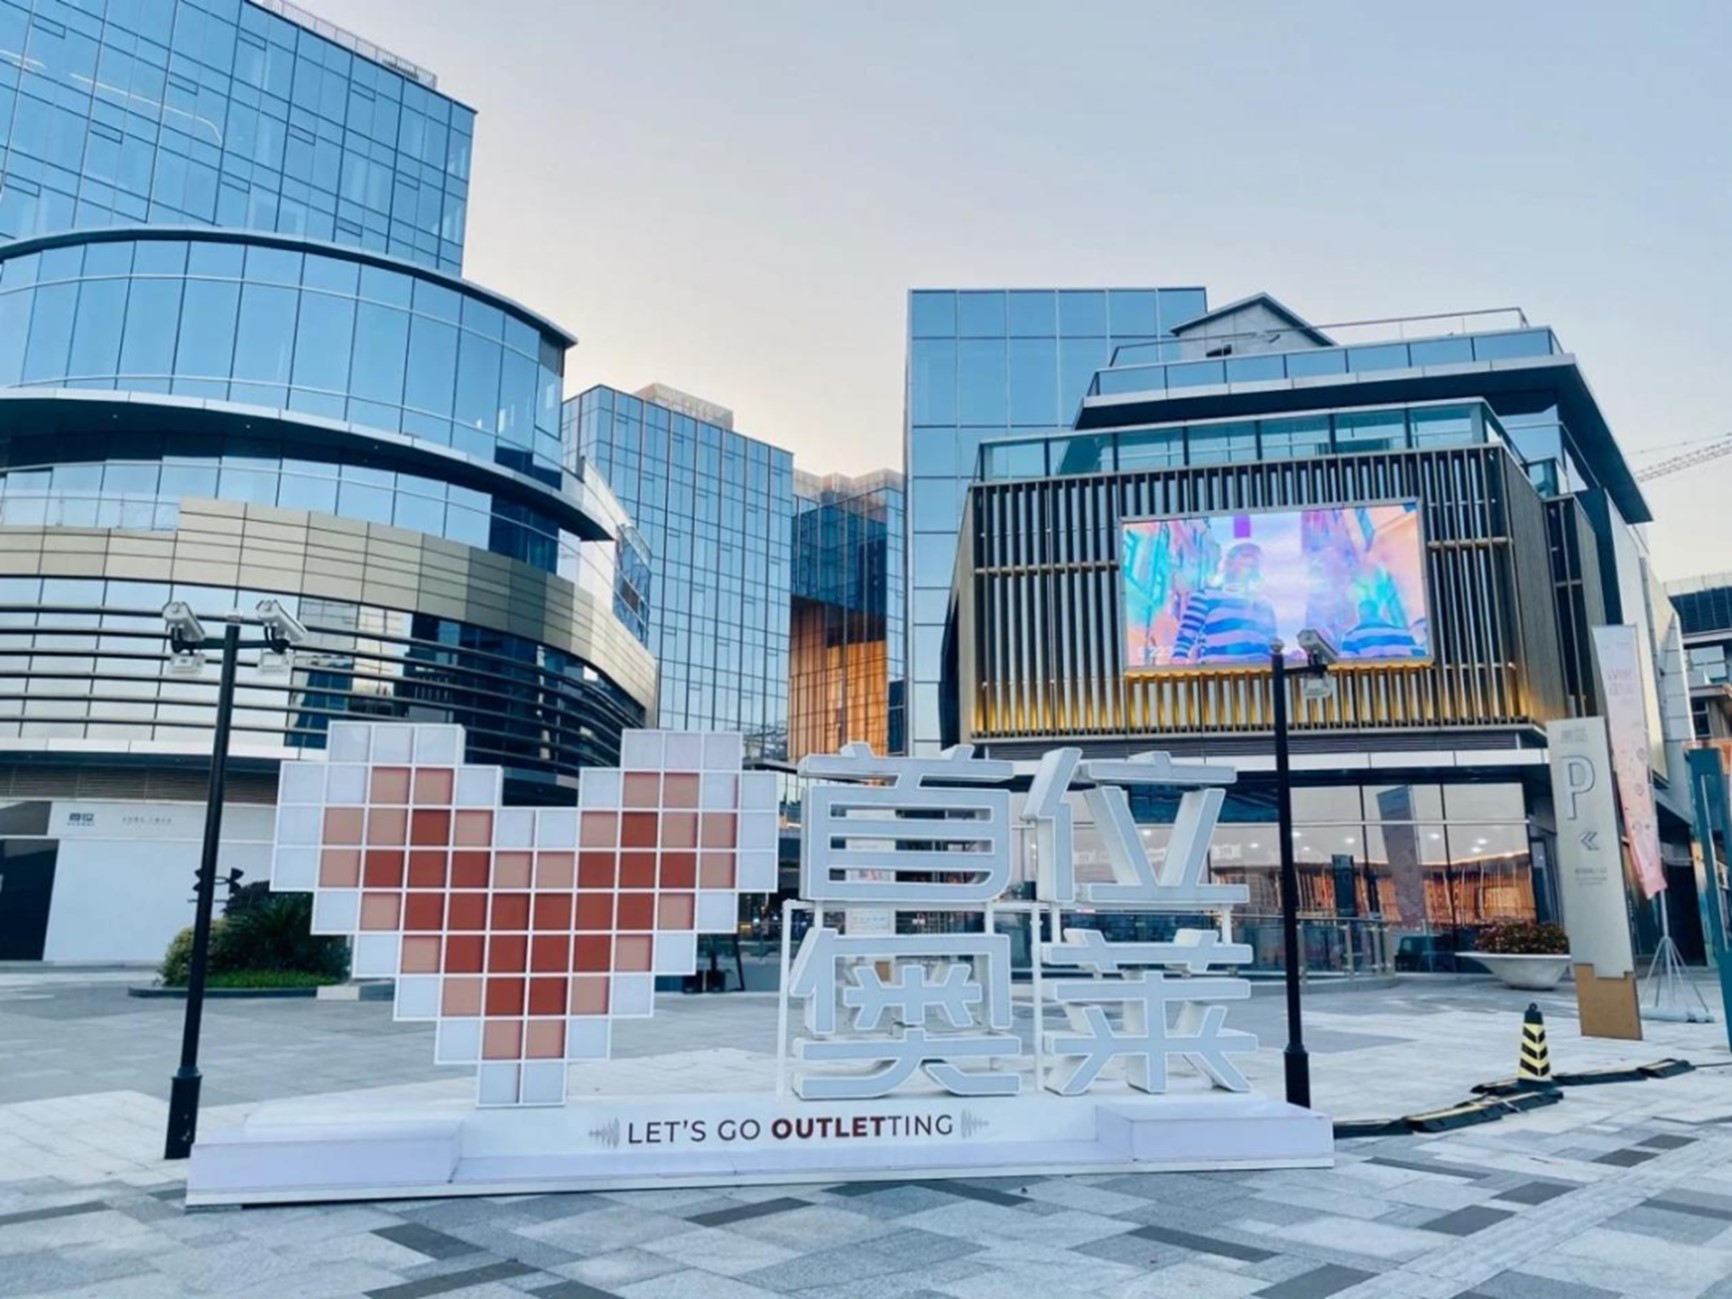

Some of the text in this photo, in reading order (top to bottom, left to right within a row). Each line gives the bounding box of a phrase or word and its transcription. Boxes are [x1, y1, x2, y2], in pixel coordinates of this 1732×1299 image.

[797, 741, 1250, 902] 首位
[1561, 754, 1596, 821] P
[790, 927, 1258, 1099] 奥莱
[628, 1114, 954, 1145] LET'S GO OUTLETTING
